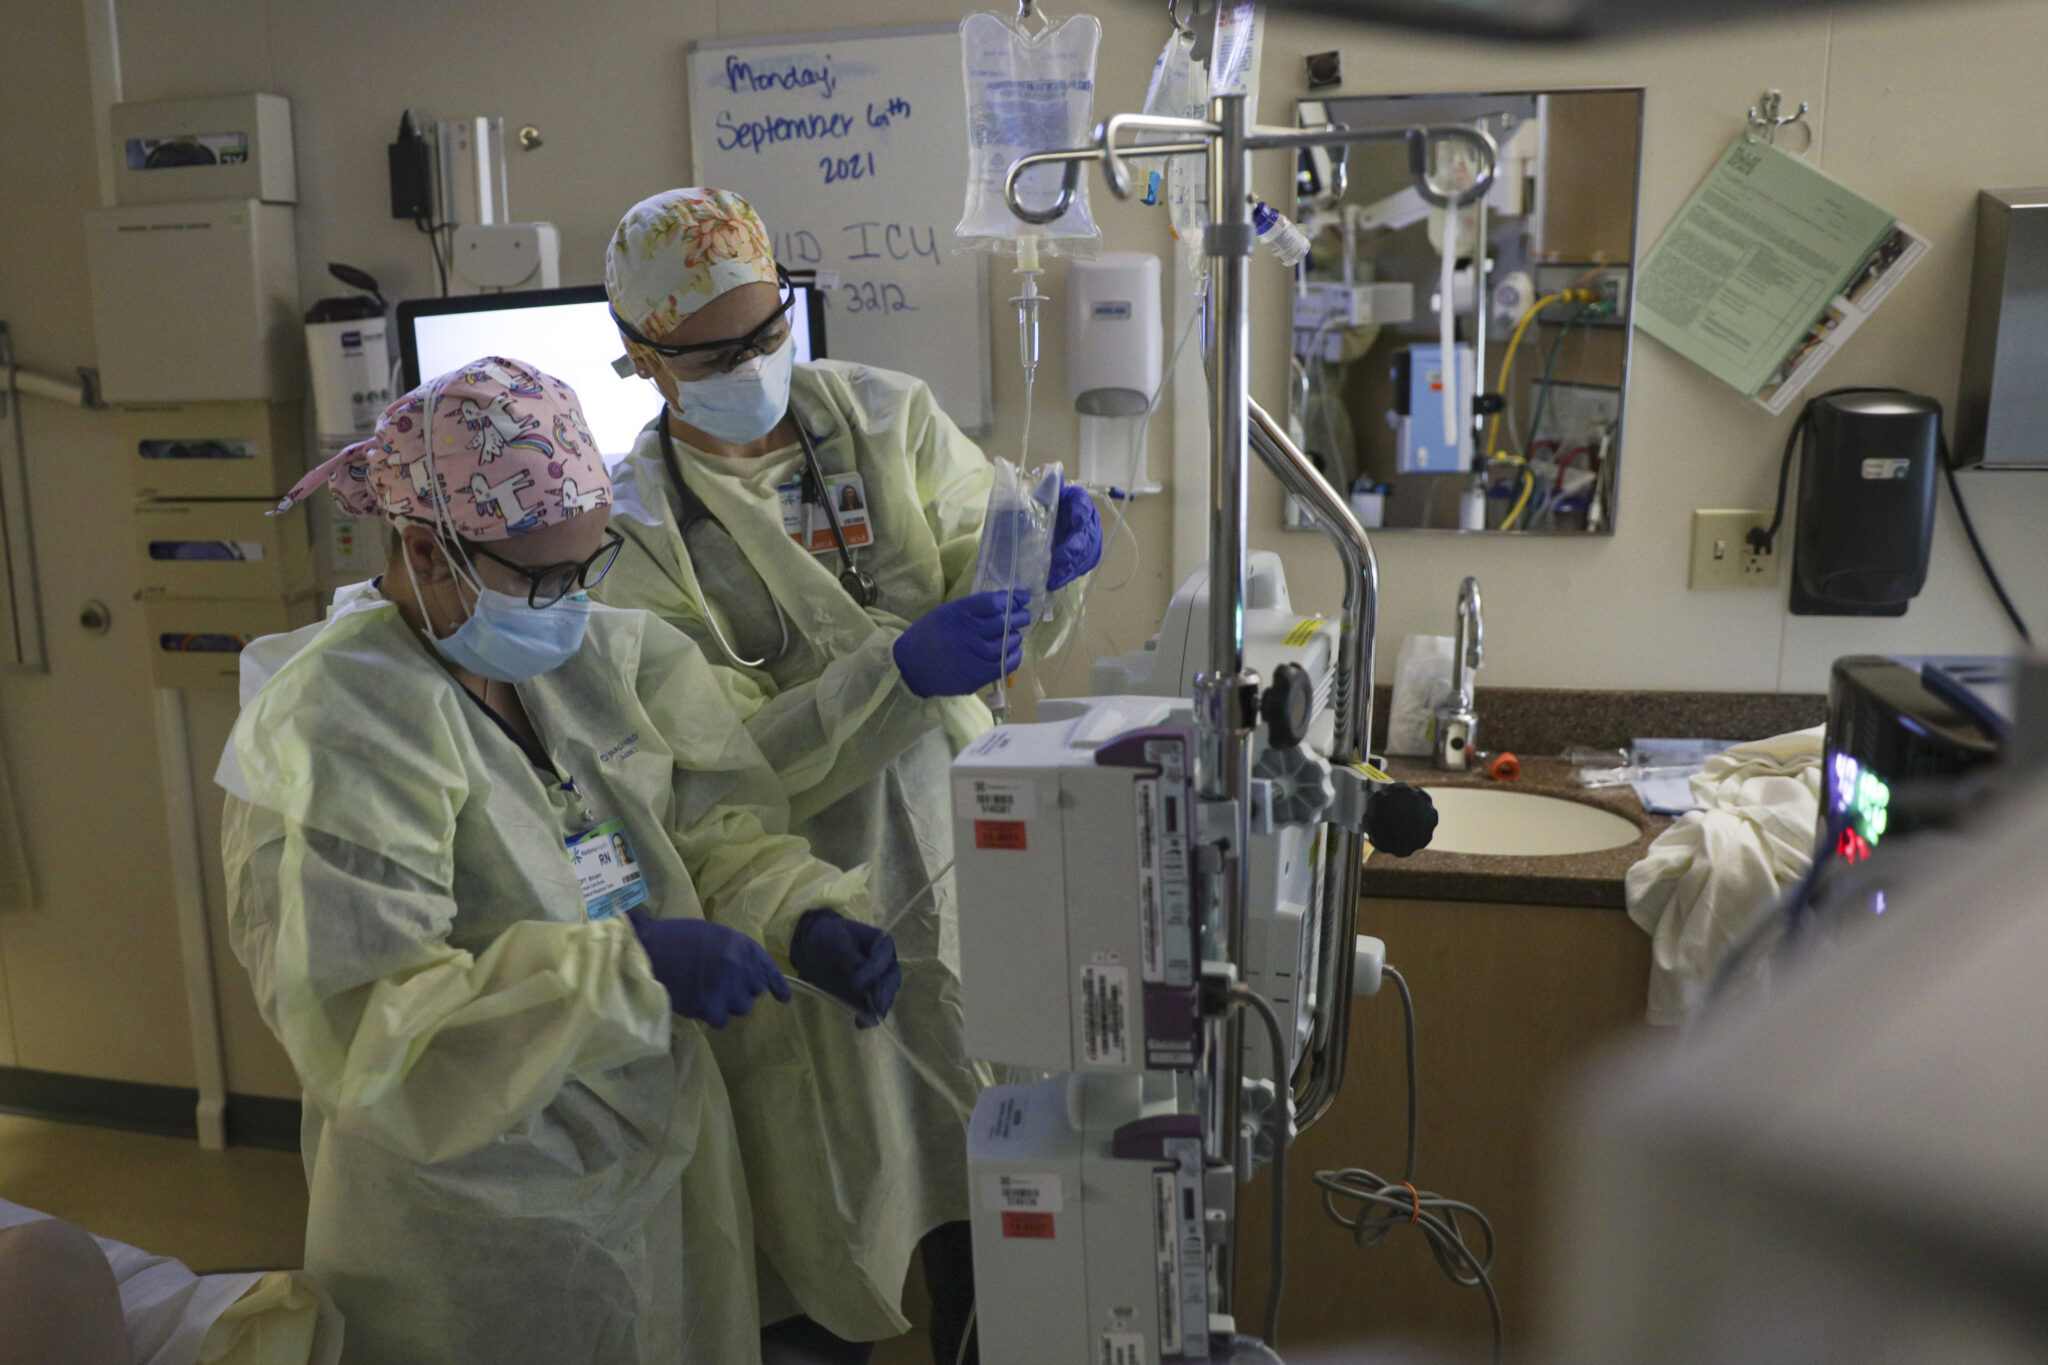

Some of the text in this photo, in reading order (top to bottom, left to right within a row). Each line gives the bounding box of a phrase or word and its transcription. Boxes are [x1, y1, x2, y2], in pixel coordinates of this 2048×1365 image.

[716, 111, 853, 153] September
[819, 152, 875, 183] 2021
[843, 221, 940, 265] ICU
[598, 851, 612, 866] RN
